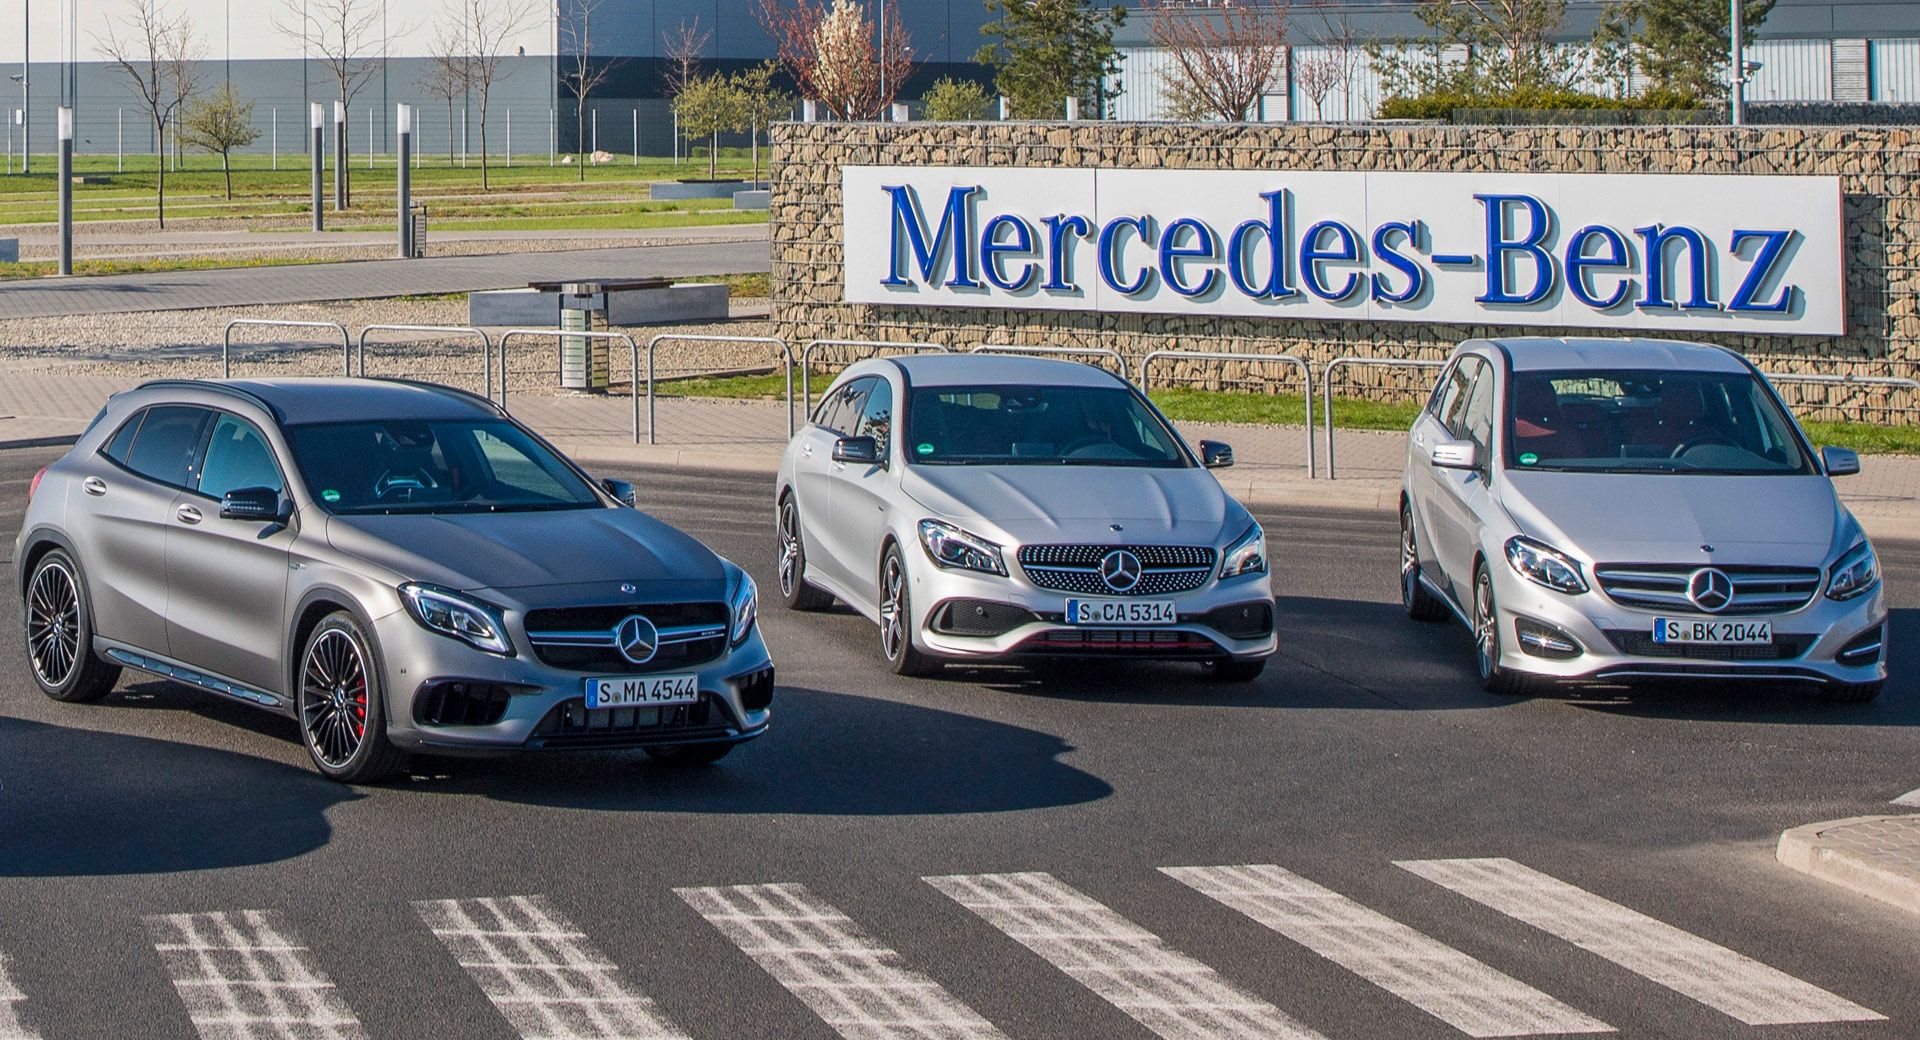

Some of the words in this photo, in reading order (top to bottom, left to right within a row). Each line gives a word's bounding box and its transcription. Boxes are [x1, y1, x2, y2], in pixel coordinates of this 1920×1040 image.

[879, 184, 1796, 314] Mercedes-Benz
[1079, 603, 1090, 621] S
[1103, 603, 1126, 621] CA
[1130, 603, 1173, 621] 5314
[1667, 621, 1679, 639] S
[1693, 622, 1717, 641] BK
[1722, 623, 1768, 641] 2044
[599, 683, 611, 703] S
[623, 681, 647, 702] MA
[651, 679, 695, 700] 4544
